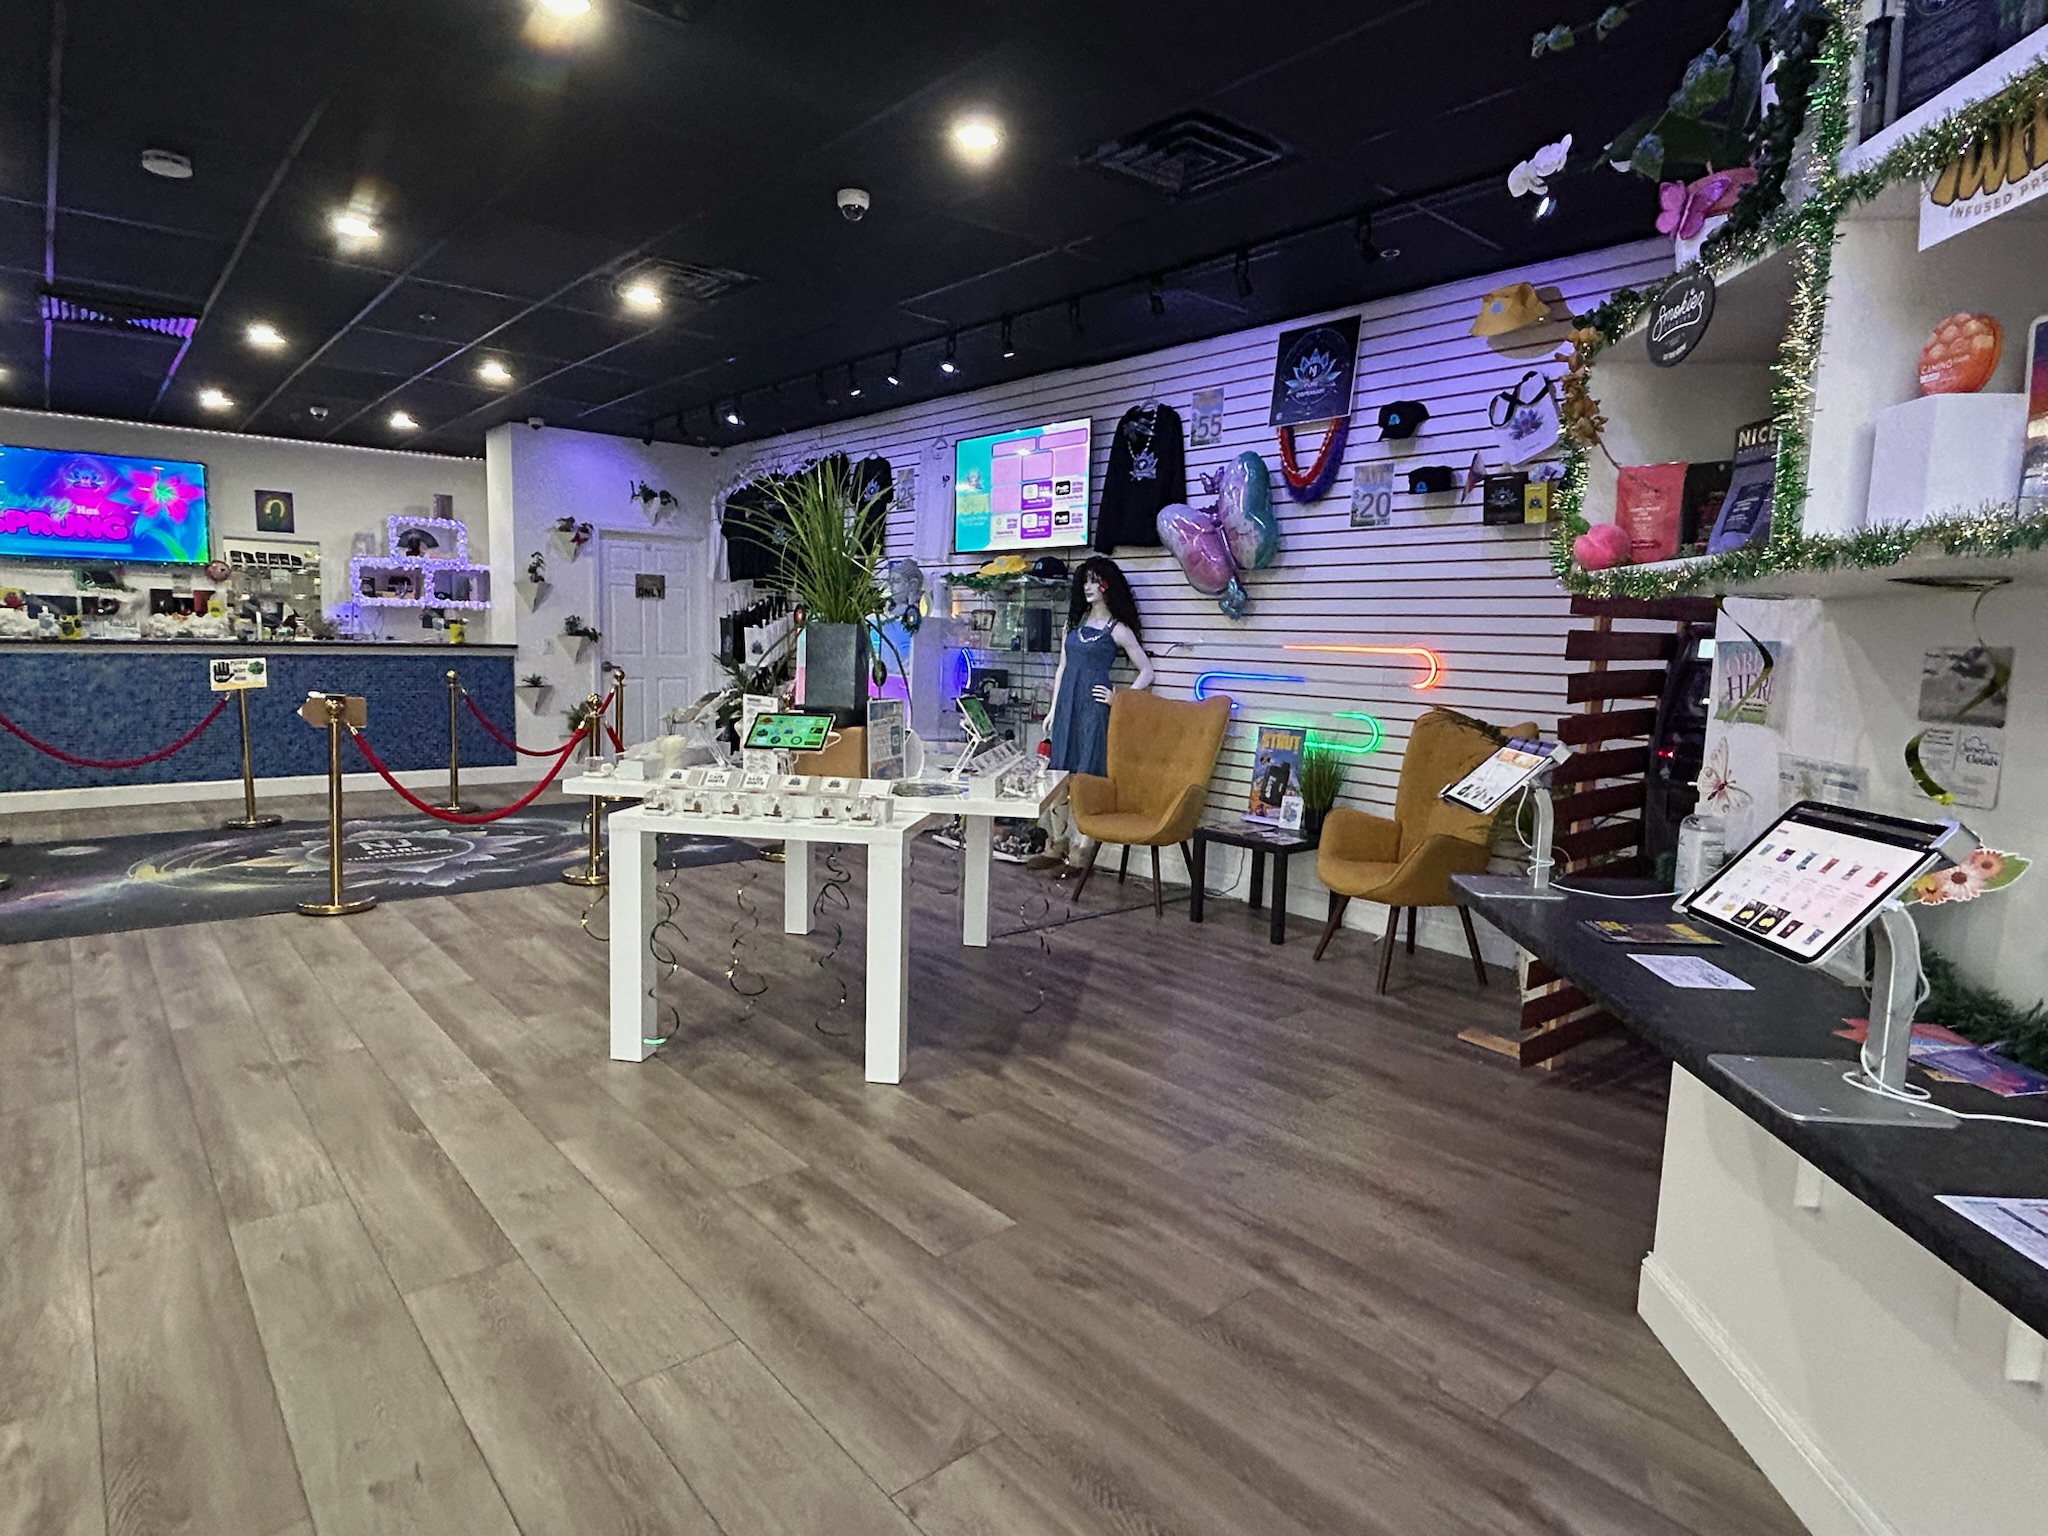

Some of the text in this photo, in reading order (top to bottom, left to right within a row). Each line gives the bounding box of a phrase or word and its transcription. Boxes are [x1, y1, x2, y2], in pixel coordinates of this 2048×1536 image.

[1951, 193, 2012, 218] INFUSED
[1738, 424, 1777, 448] NICE
[1353, 489, 1392, 519] $20
